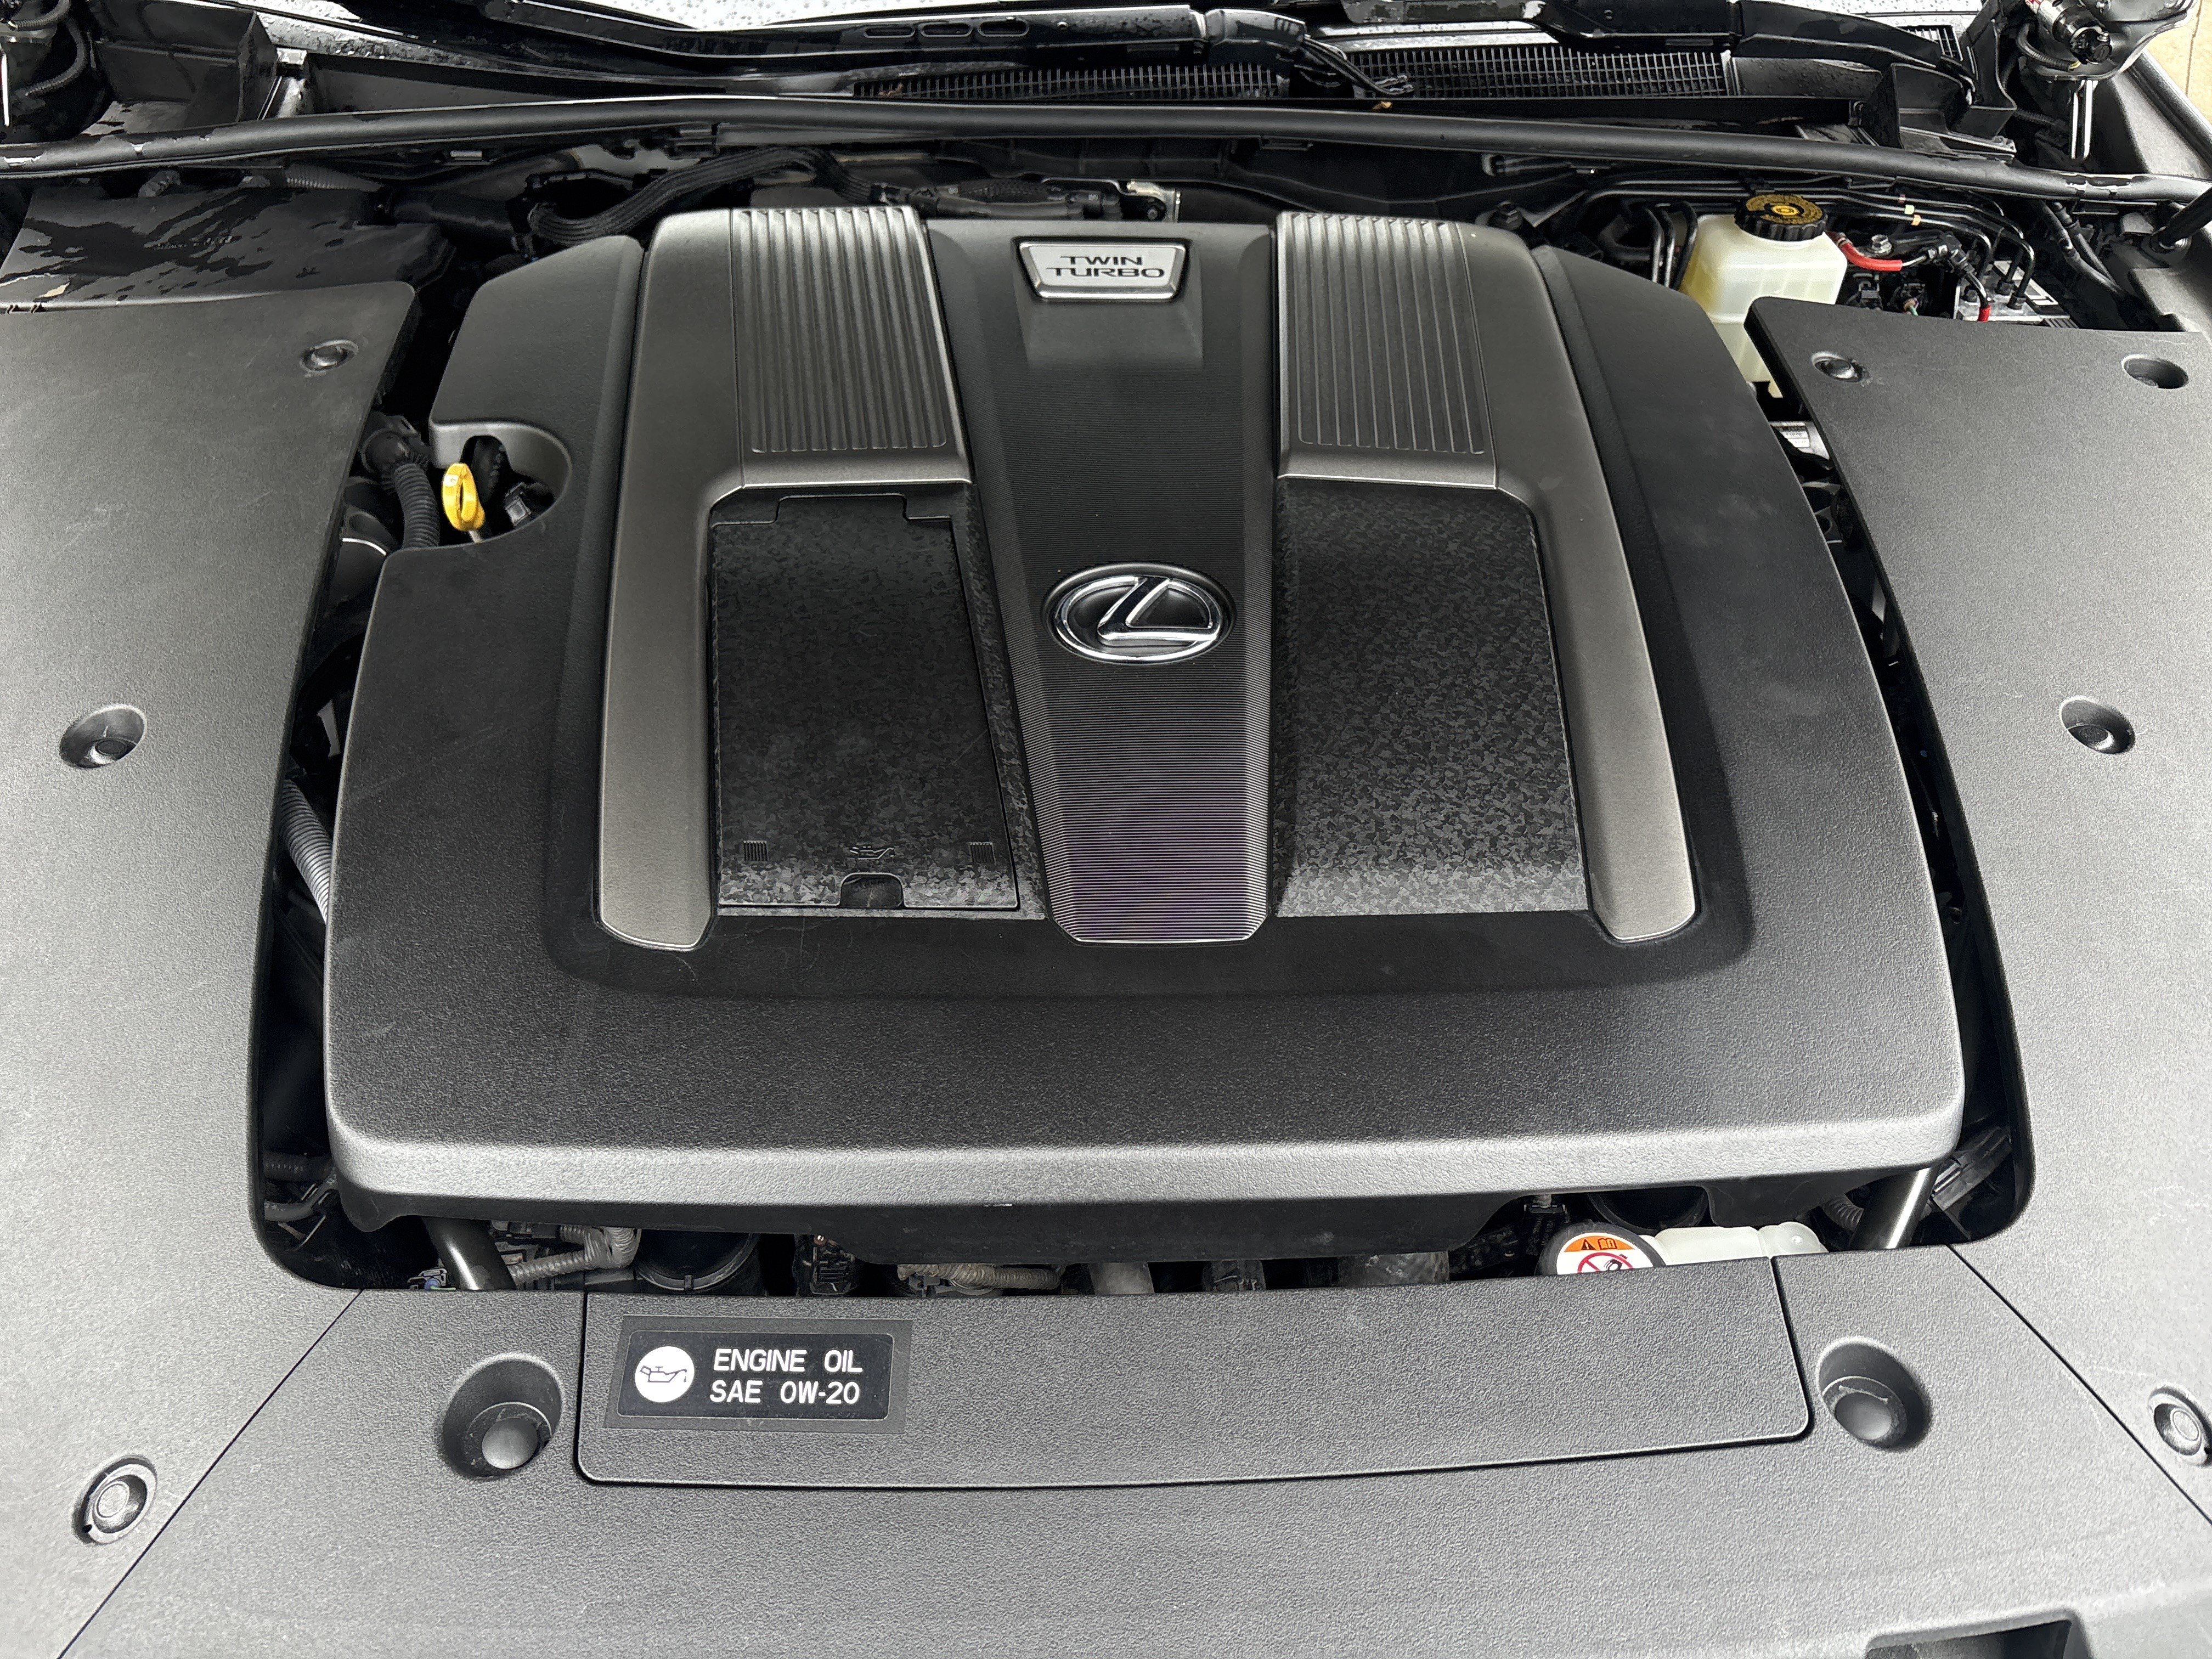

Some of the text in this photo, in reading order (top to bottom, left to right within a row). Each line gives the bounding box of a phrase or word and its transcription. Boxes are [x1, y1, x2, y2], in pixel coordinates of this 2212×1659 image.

[1060, 255, 1143, 266] TWIN
[1046, 267, 1165, 278] TURBO
[713, 1348, 864, 1373] ENGINE OIL
[709, 1379, 861, 1404] SAE 0W-20
